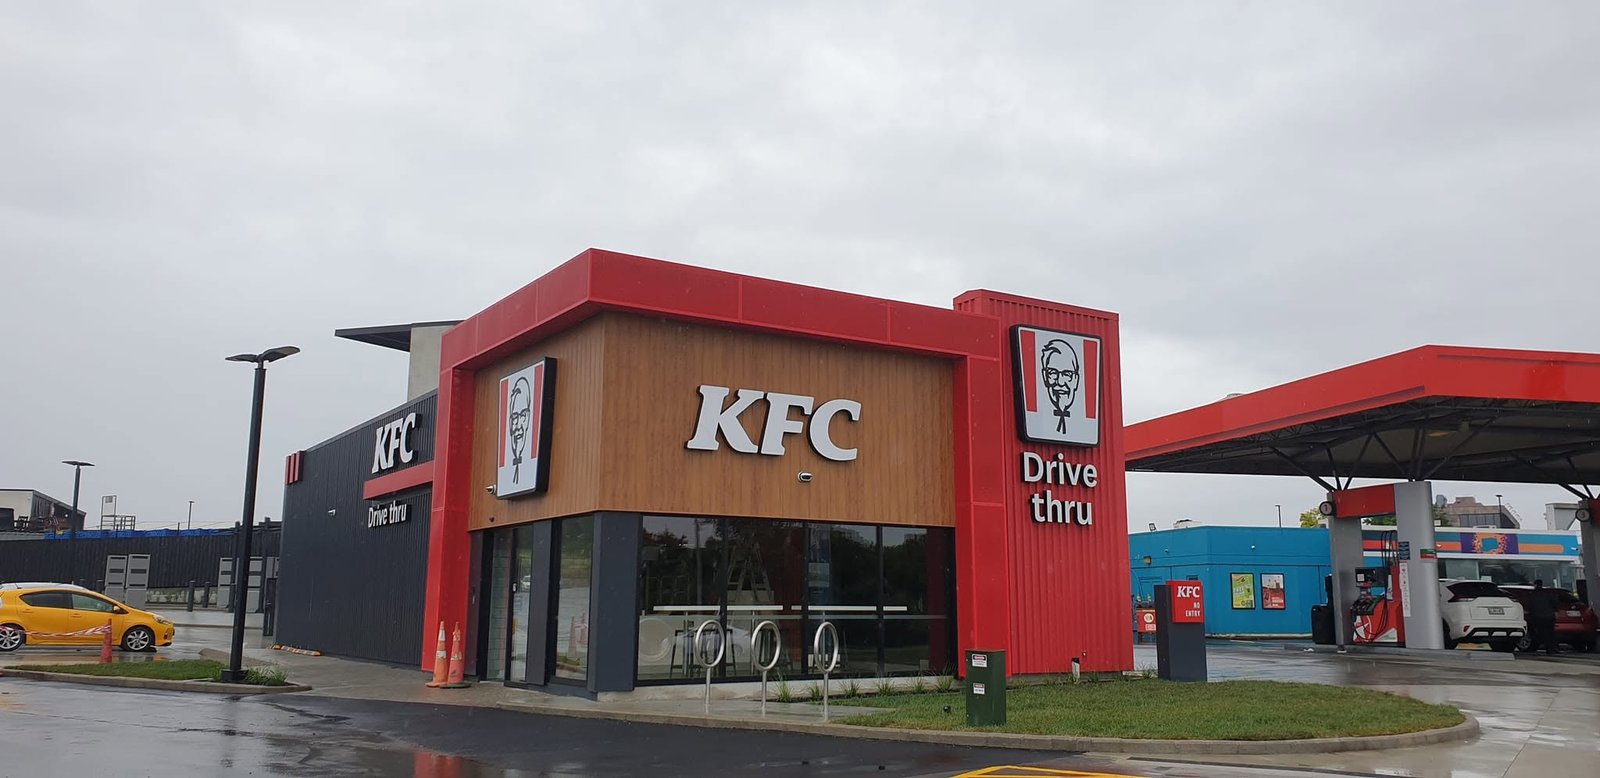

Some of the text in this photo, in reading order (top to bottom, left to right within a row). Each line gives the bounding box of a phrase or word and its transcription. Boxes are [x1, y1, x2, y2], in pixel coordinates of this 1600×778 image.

[686, 384, 862, 462] KFC
[371, 412, 416, 474] KFC
[1023, 451, 1098, 488] Drive
[368, 499, 407, 529] Drive thru
[1031, 489, 1093, 525] thru
[1176, 585, 1201, 598] KFC
[1193, 601, 1201, 609] NO
